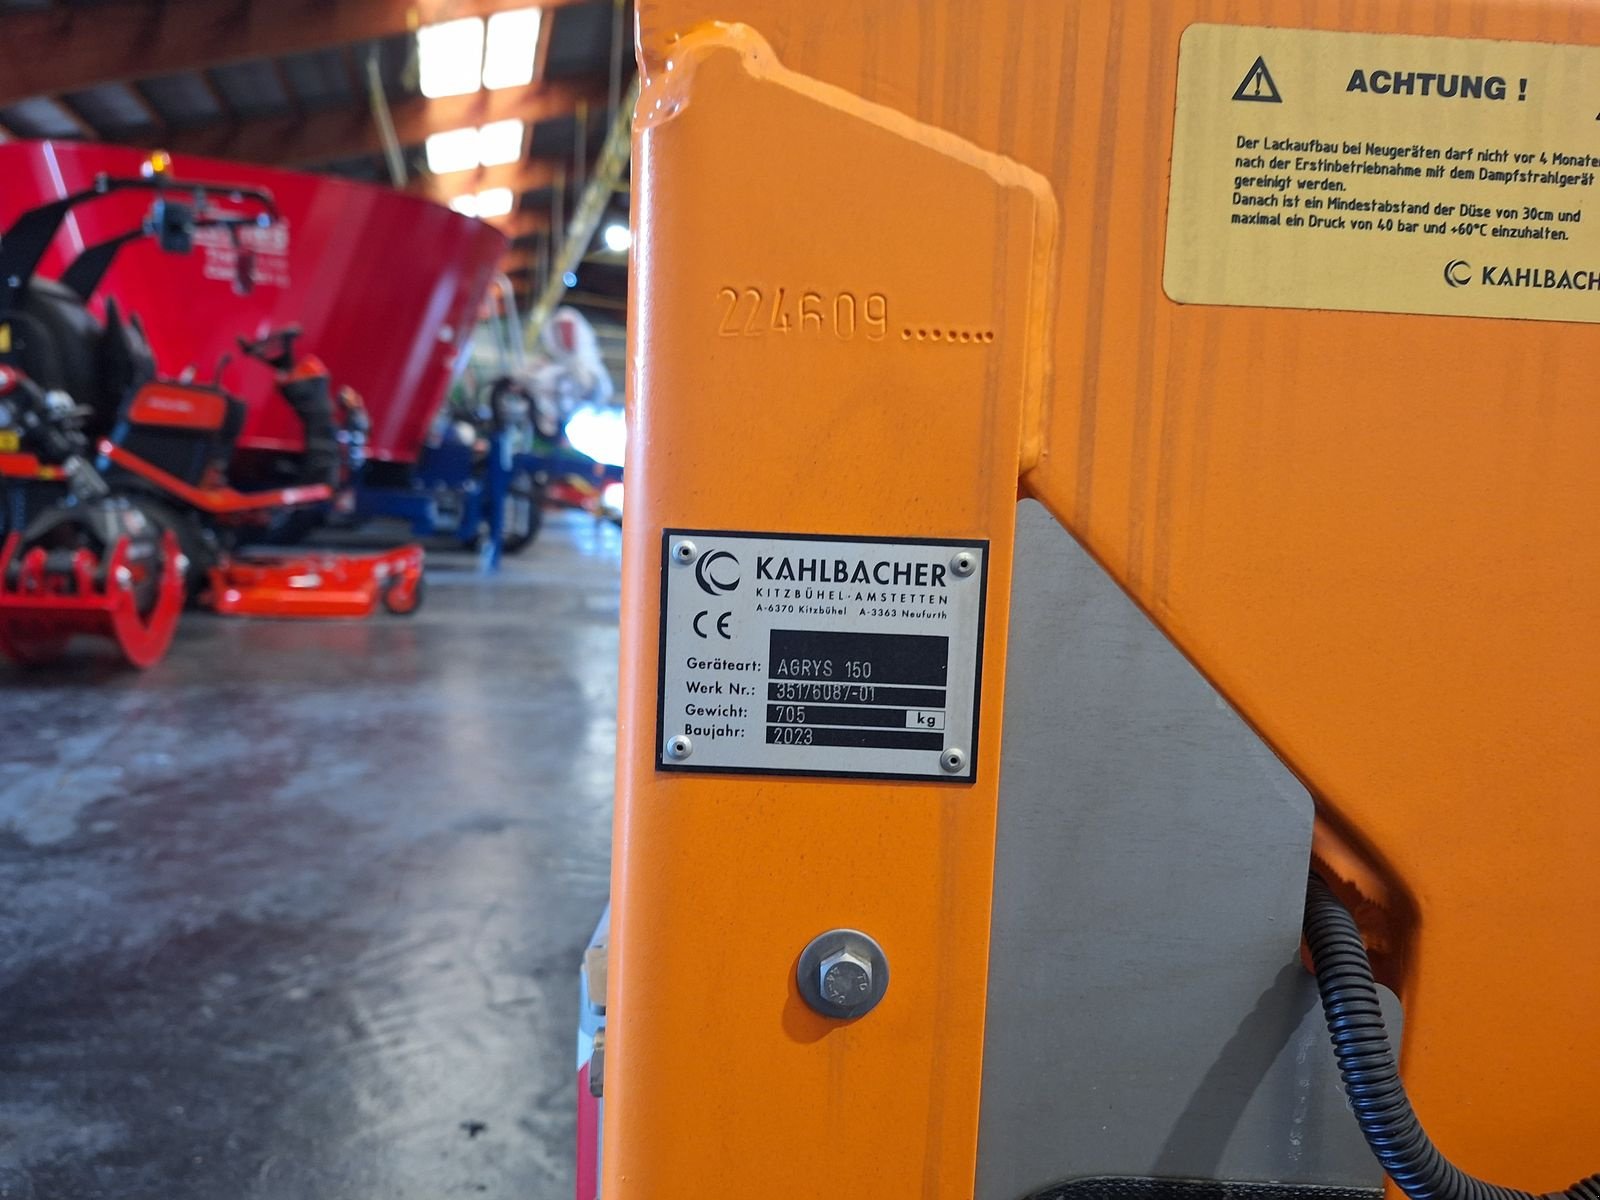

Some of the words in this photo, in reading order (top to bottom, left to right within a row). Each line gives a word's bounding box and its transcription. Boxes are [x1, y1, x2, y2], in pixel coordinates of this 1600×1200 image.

[1346, 69, 1506, 100] ACHTUNG
[1518, 78, 1528, 101] !
[1237, 135, 1259, 149] Der
[1264, 137, 1338, 154] Lackaufbau
[1343, 142, 1361, 154] bei
[1366, 142, 1440, 160] Neugeräten
[1445, 148, 1473, 161] darf
[1477, 149, 1509, 163] nicht
[1514, 153, 1535, 164] vor
[1540, 152, 1548, 165] 4
[1552, 153, 1600, 167] Monate
[1234, 174, 1291, 191] gereinigt
[1297, 178, 1347, 192] werden.
[1235, 156, 1264, 169] nach
[1269, 156, 1291, 170] der
[1295, 158, 1421, 177] Erstinbetriebnahme
[1426, 165, 1446, 178] mit
[1450, 166, 1475, 180] dem
[1479, 167, 1595, 187] Dampfstrahlgerät
[1232, 192, 1278, 207] Danach
[1282, 194, 1300, 207] ist
[1305, 196, 1323, 209] ein
[1327, 197, 1430, 214] Mindestabstand
[1434, 203, 1455, 216] der
[1460, 204, 1491, 218] Düse
[1496, 208, 1518, 220] von
[1522, 207, 1554, 221] 30cm
[1558, 210, 1581, 222] und
[1231, 212, 1281, 226] maximal
[1286, 214, 1304, 227] ein
[1309, 215, 1345, 229] Druck
[1350, 219, 1372, 230] von
[1377, 218, 1393, 231] 40
[1397, 220, 1419, 233] bar
[1424, 222, 1446, 234] und
[1450, 223, 1488, 236] +60°C
[1491, 226, 1569, 240] einzuhalten.
[756, 556, 947, 588] KAHLBACHER
[693, 610, 732, 640] CE
[756, 604, 794, 614] A-6370
[799, 605, 847, 616] Kitzbühel
[859, 608, 897, 618] A-3363
[901, 609, 947, 620] Neufurth
[686, 657, 761, 672] Geräteart:
[777, 658, 833, 677] AGRYS
[845, 661, 872, 679] 150
[686, 681, 722, 695] Werk
[729, 682, 755, 696] Nr.:
[685, 704, 748, 718] Gewicht:
[775, 706, 806, 723] 705
[917, 711, 936, 728] kg
[685, 723, 745, 740] Baujahr:
[774, 727, 813, 745] 2023
